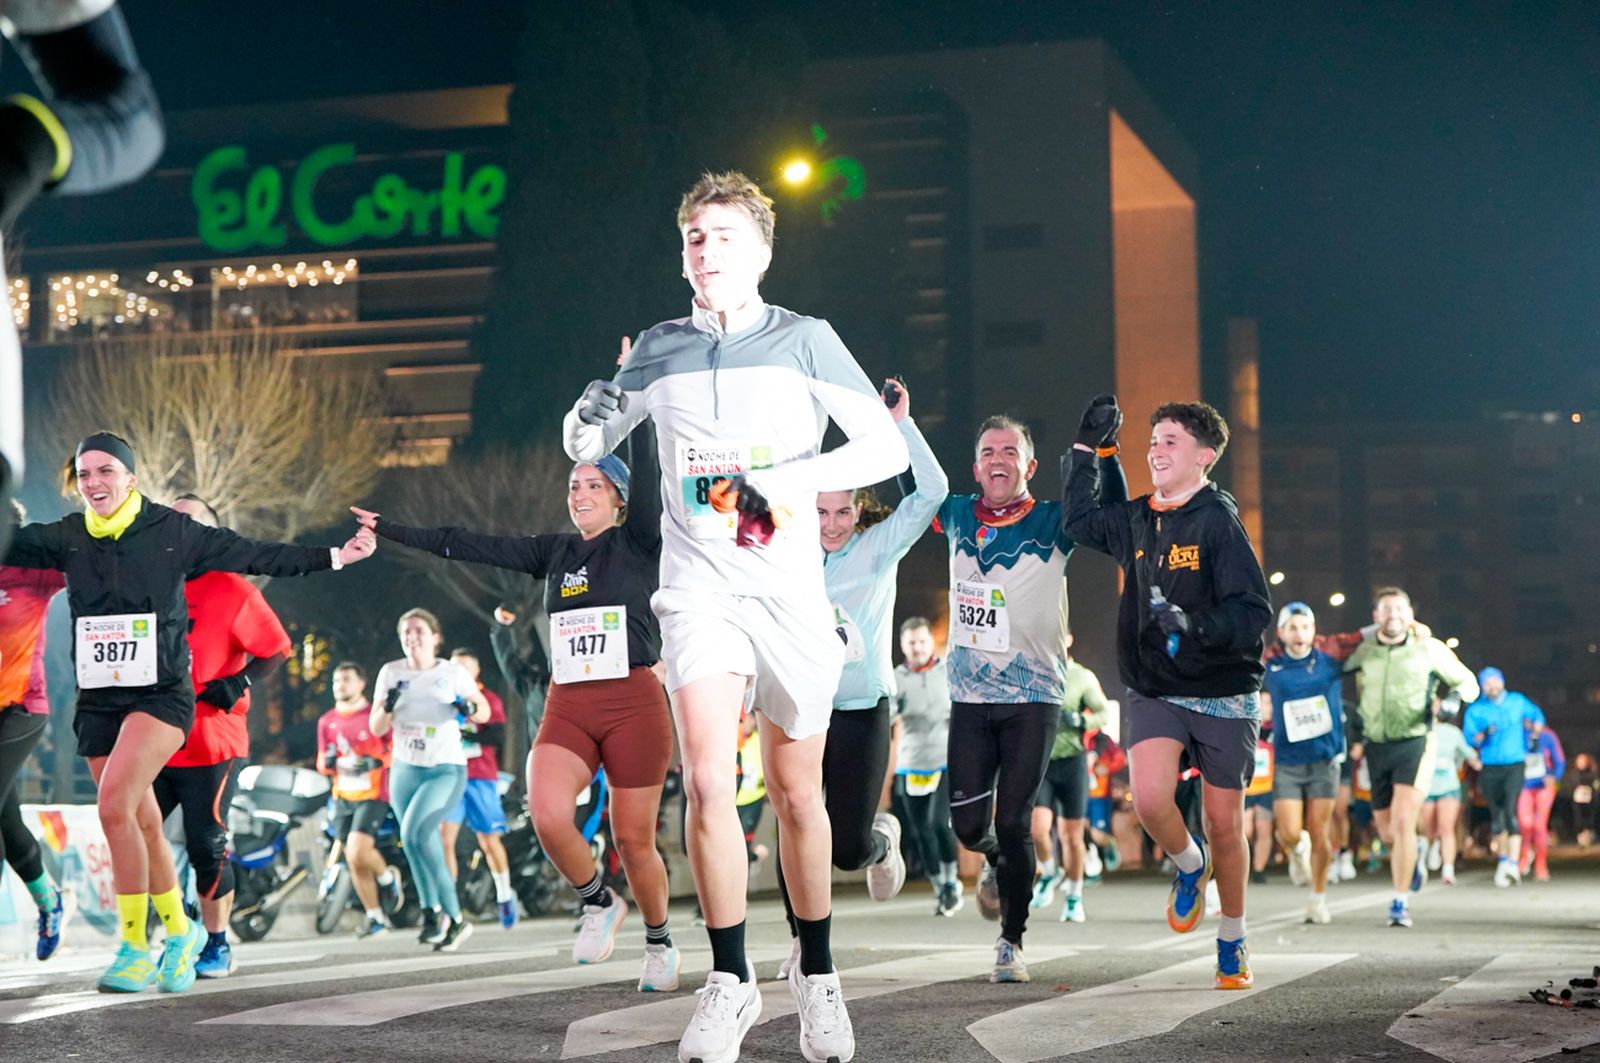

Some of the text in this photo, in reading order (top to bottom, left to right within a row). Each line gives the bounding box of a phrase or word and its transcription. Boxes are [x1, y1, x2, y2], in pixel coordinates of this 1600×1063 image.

[191, 144, 506, 250] El Corte
[698, 451, 740, 462] NOCHE DE
[688, 464, 706, 476] SAN
[1168, 550, 1199, 565] ULTRA
[561, 584, 589, 598] BOX
[959, 604, 997, 628] 5324
[93, 624, 115, 632] NOCHE
[116, 623, 126, 631] DE
[85, 633, 100, 641] SAN
[94, 641, 138, 663] 3877
[568, 634, 607, 657] 1477
[86, 843, 112, 875] SA
